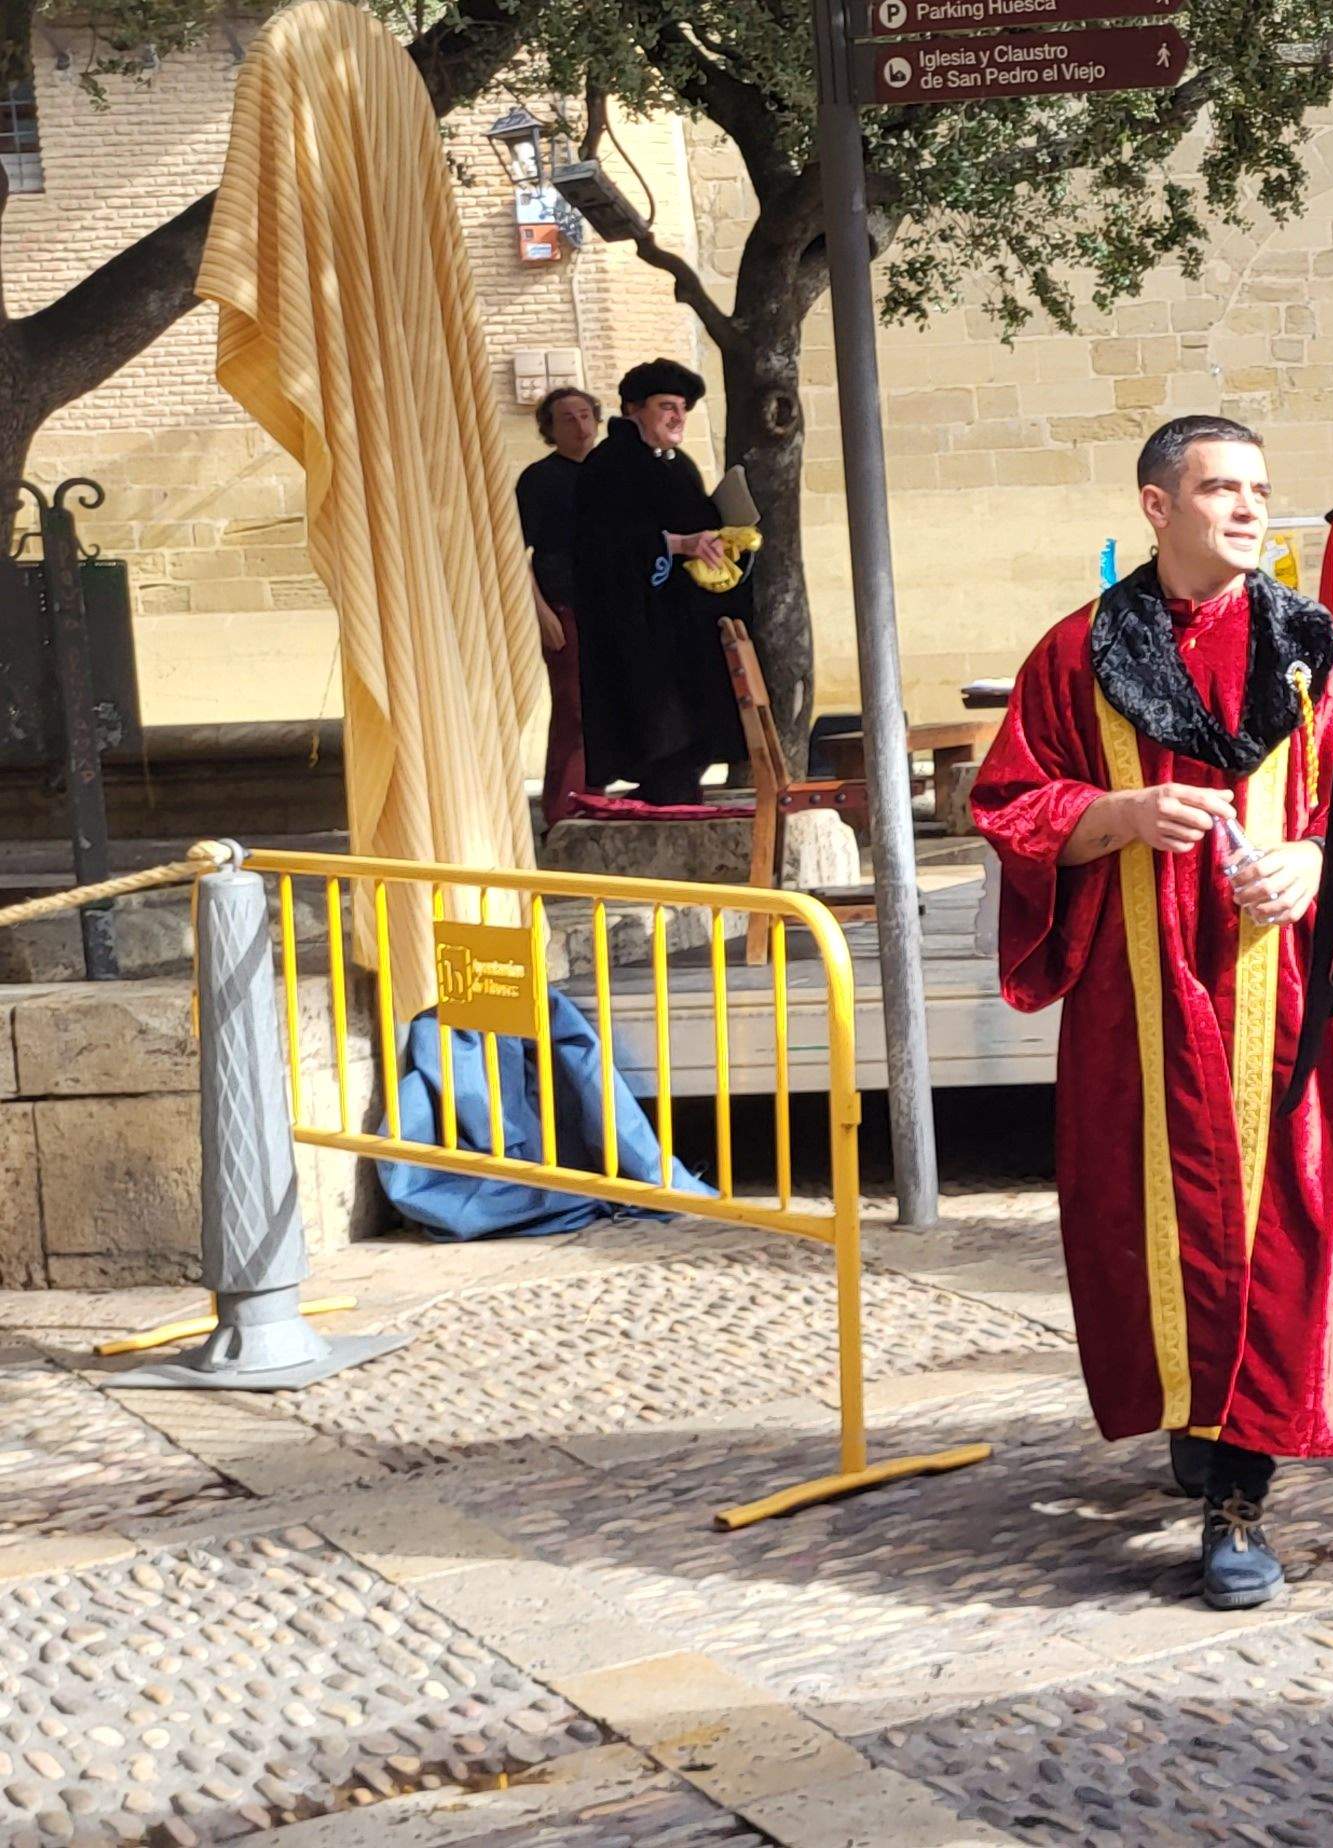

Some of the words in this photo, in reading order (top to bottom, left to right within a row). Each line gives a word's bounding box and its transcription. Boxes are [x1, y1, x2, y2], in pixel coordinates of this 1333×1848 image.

[886, 4, 901, 24] P
[916, 3, 984, 20] Parking
[988, 0, 1057, 15] Huesca
[919, 48, 976, 70] Iglesia
[979, 50, 990, 68] y
[994, 43, 1068, 63] Claustro
[920, 72, 943, 89] de
[947, 70, 981, 88] San
[985, 66, 1039, 86] Pedro
[1042, 64, 1058, 82] el
[1061, 61, 1106, 83] Viejo
